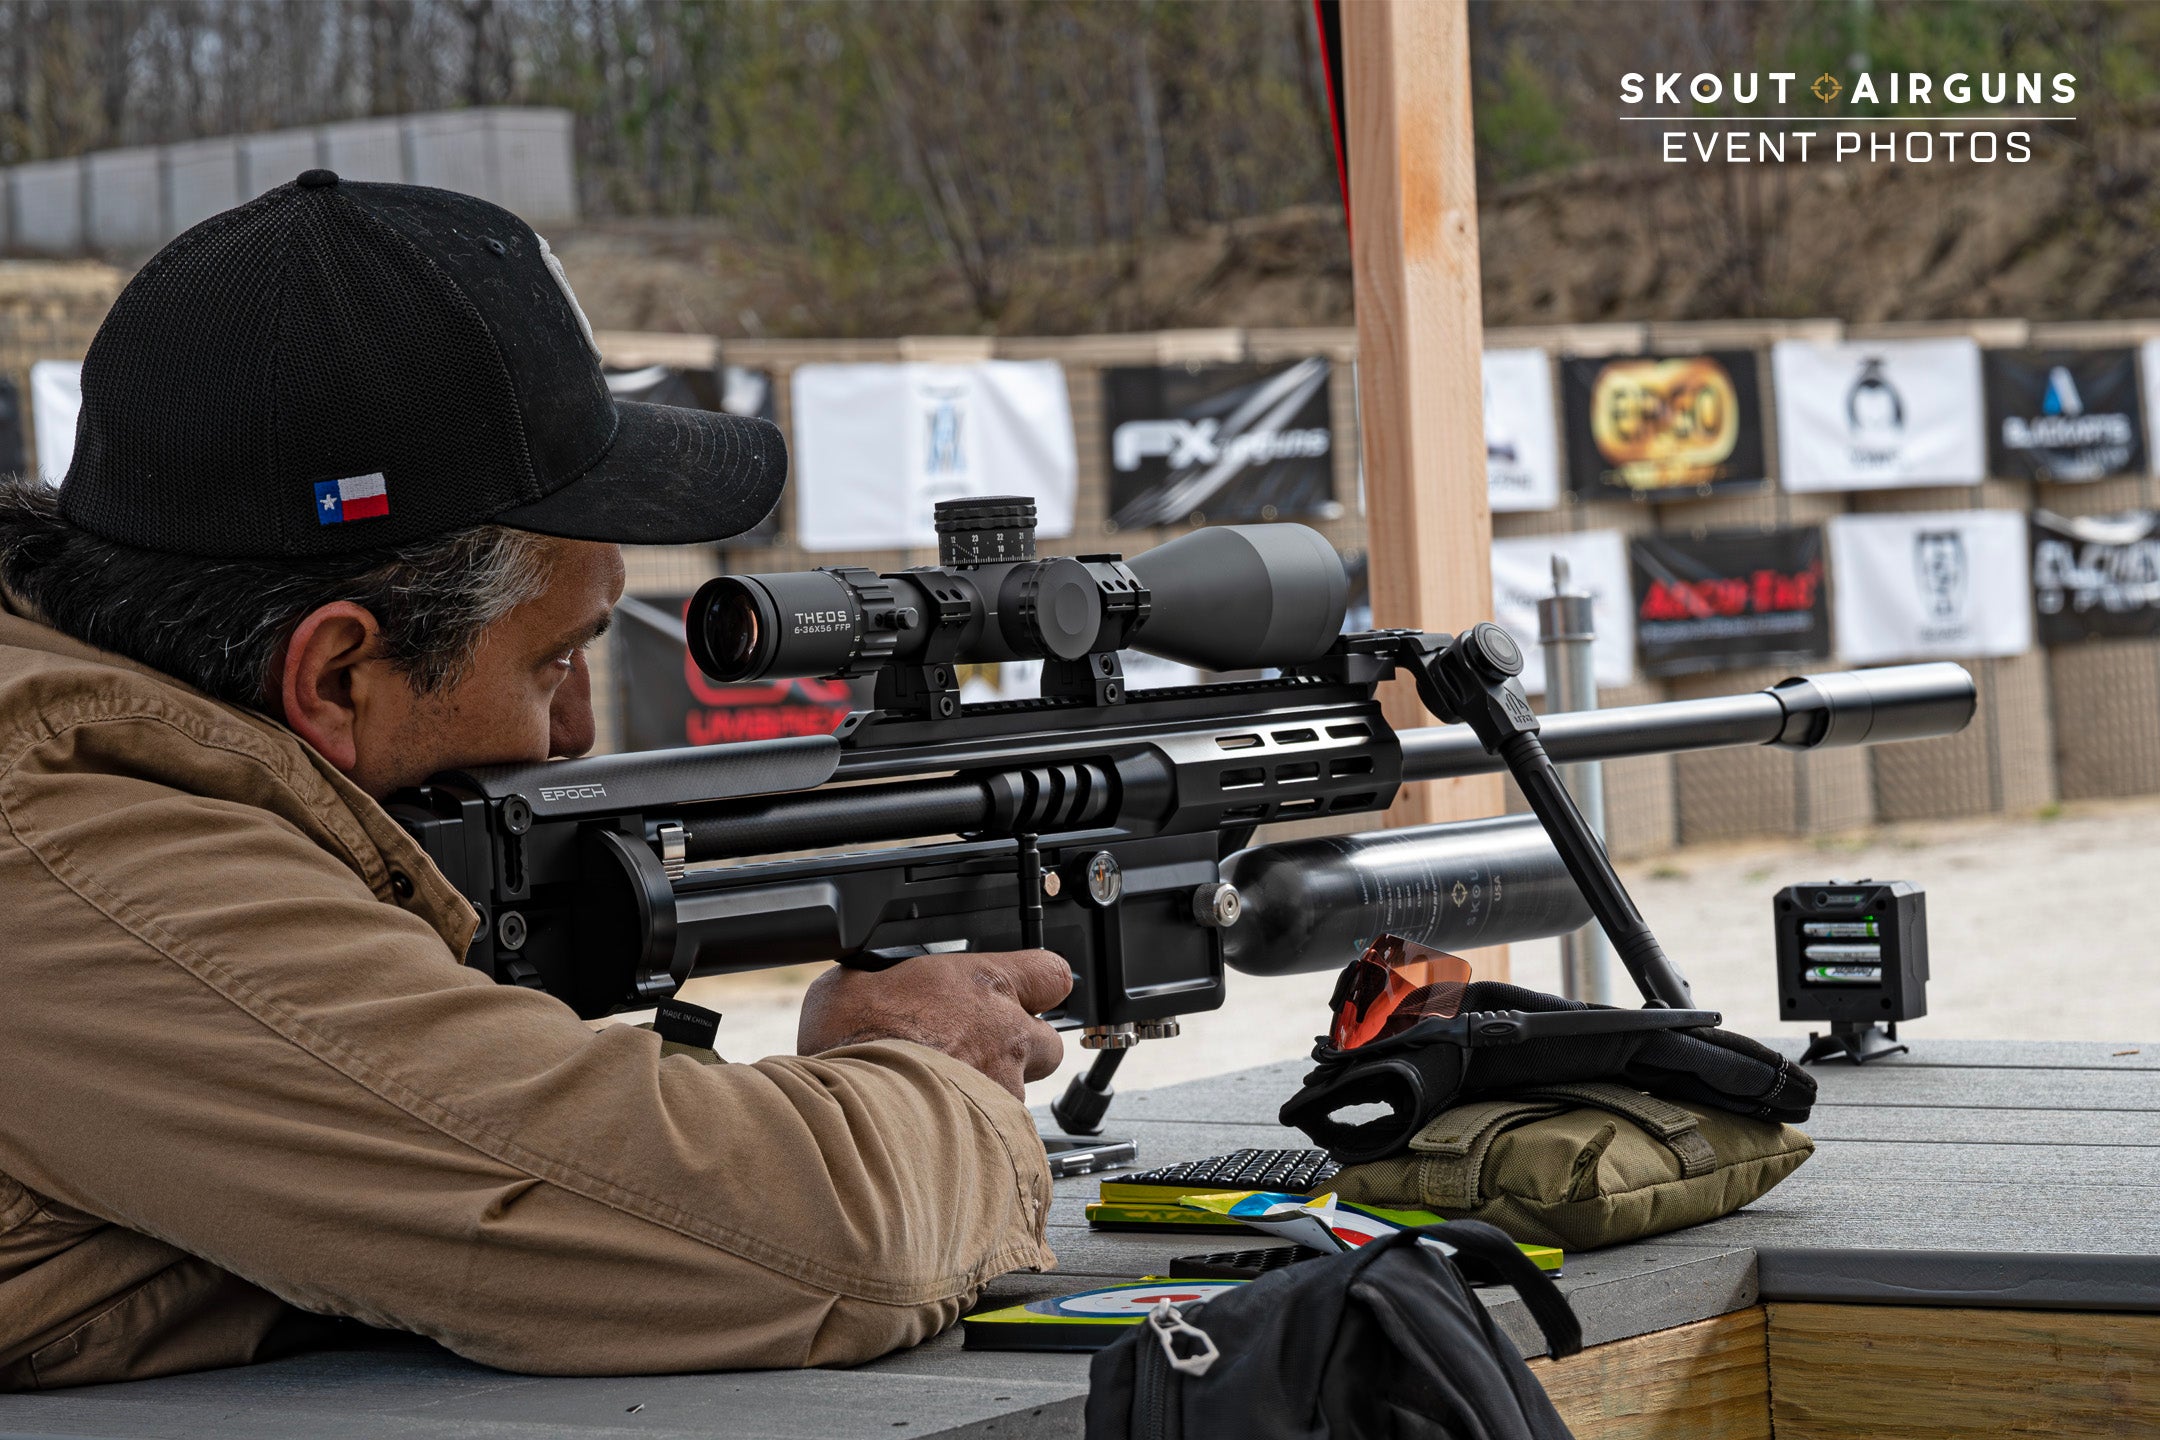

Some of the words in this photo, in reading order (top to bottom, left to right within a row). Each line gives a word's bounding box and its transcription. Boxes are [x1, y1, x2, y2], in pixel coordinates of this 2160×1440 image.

[1113, 418, 1219, 472] FX
[971, 534, 979, 542] 23
[996, 533, 1004, 541] 22
[997, 545, 1005, 553] 10
[794, 610, 847, 624] THEOS
[794, 624, 832, 634] 6-36X56
[834, 623, 851, 632] FFP
[541, 786, 607, 801] EPOCH
[1493, 875, 1502, 902] USA
[662, 1009, 682, 1020] MADE
[682, 1013, 692, 1022] IN
[692, 1016, 713, 1028] CHINA
